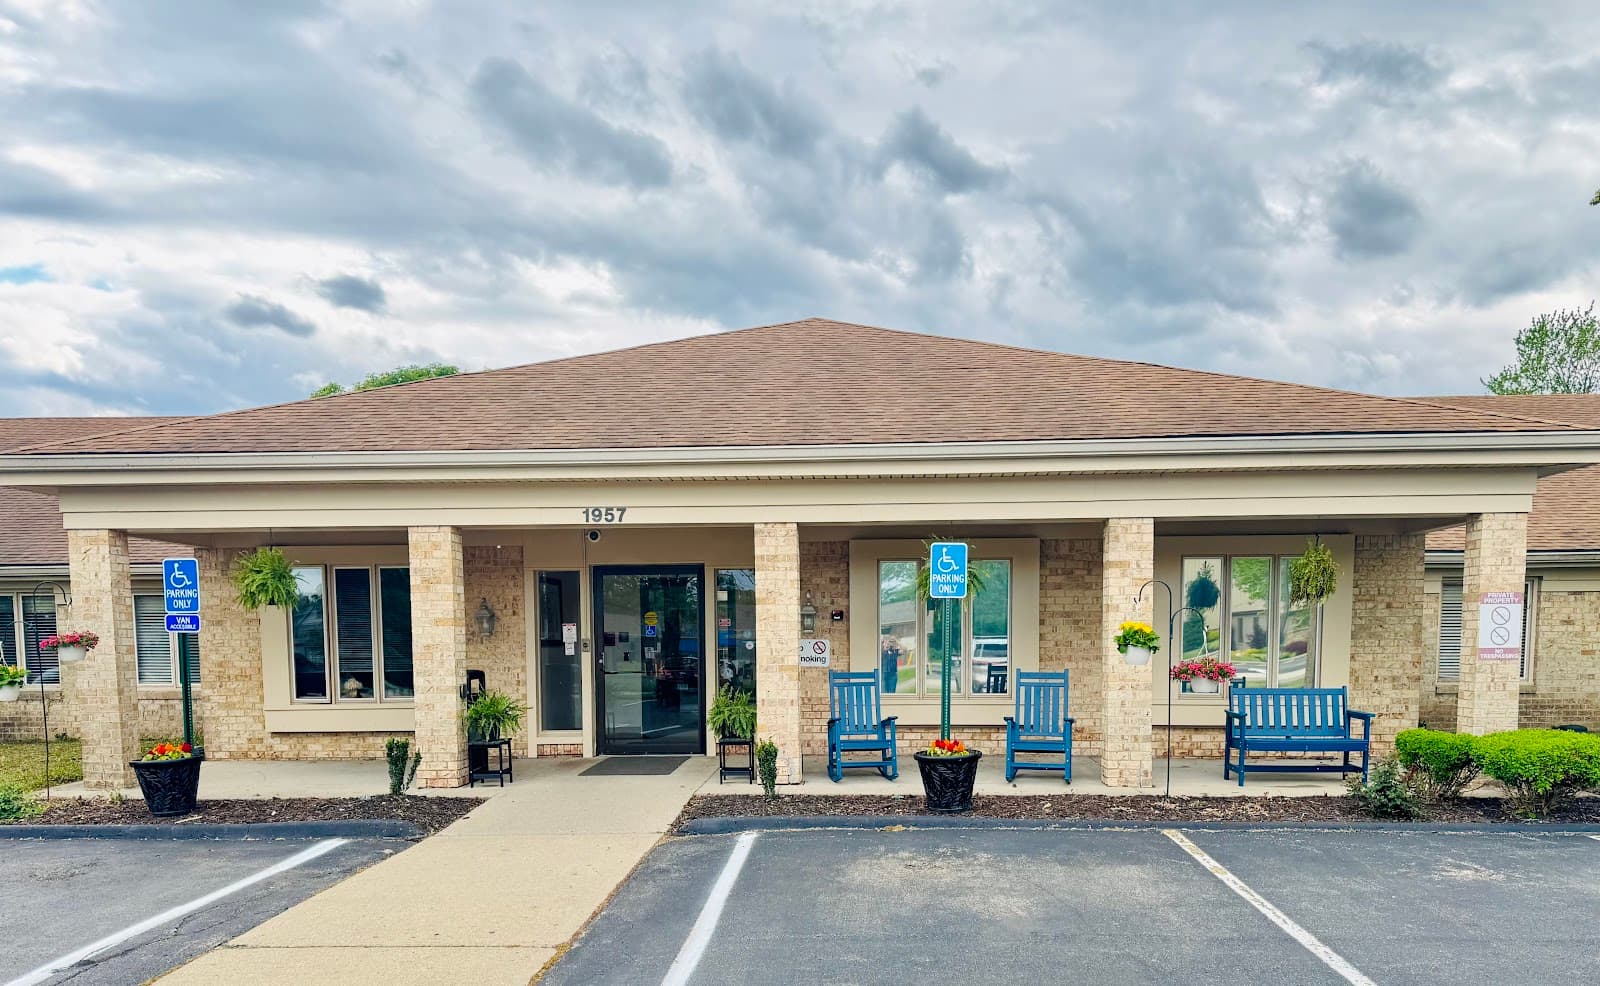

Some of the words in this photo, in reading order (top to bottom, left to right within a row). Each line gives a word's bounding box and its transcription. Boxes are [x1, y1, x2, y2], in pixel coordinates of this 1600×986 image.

[582, 507, 627, 523] 1957
[931, 574, 965, 583] PARKING
[938, 584, 959, 593] ONLY
[166, 589, 198, 598] PARKING
[173, 599, 192, 608] ONLY
[175, 616, 191, 624] VAN
